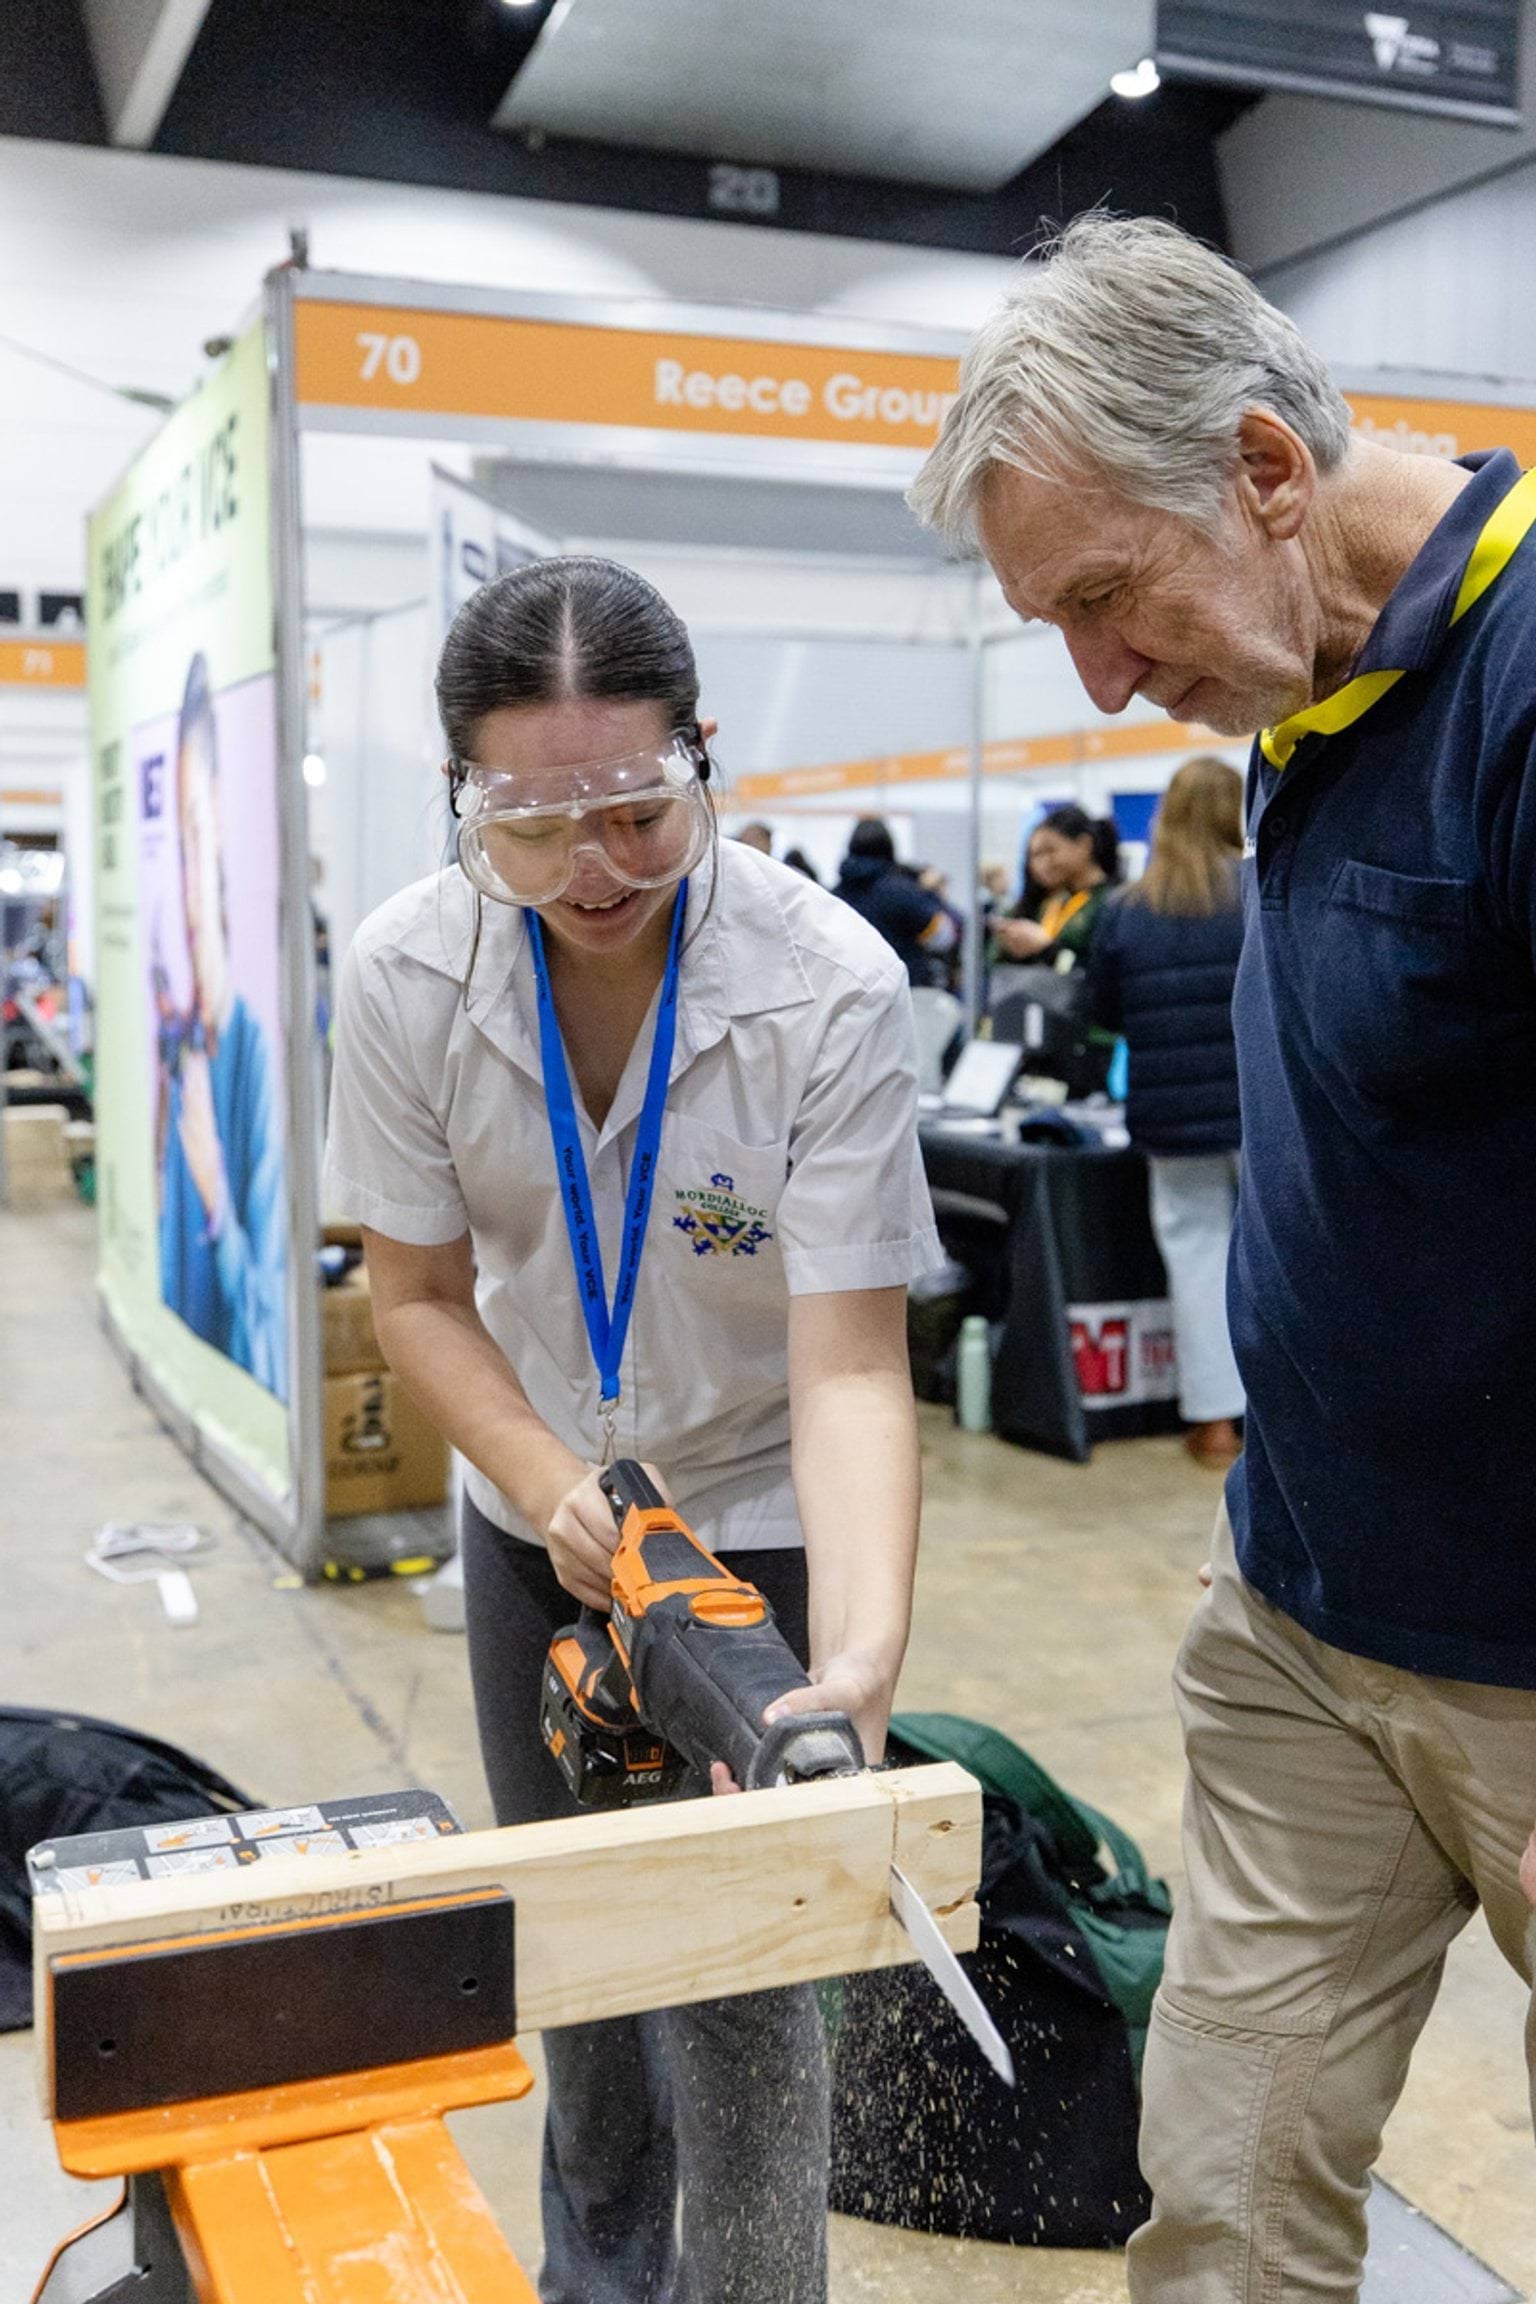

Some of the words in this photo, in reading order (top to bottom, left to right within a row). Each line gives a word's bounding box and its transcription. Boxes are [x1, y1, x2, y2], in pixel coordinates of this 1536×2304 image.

[356, 332, 421, 384] 70
[655, 358, 811, 416] Reece
[563, 1145, 576, 1179] Your
[579, 1231, 591, 1265] Your
[633, 1188, 646, 1219] Your
[675, 1190, 768, 1218] MORDIALLOC
[622, 1771, 662, 1786] AEG
